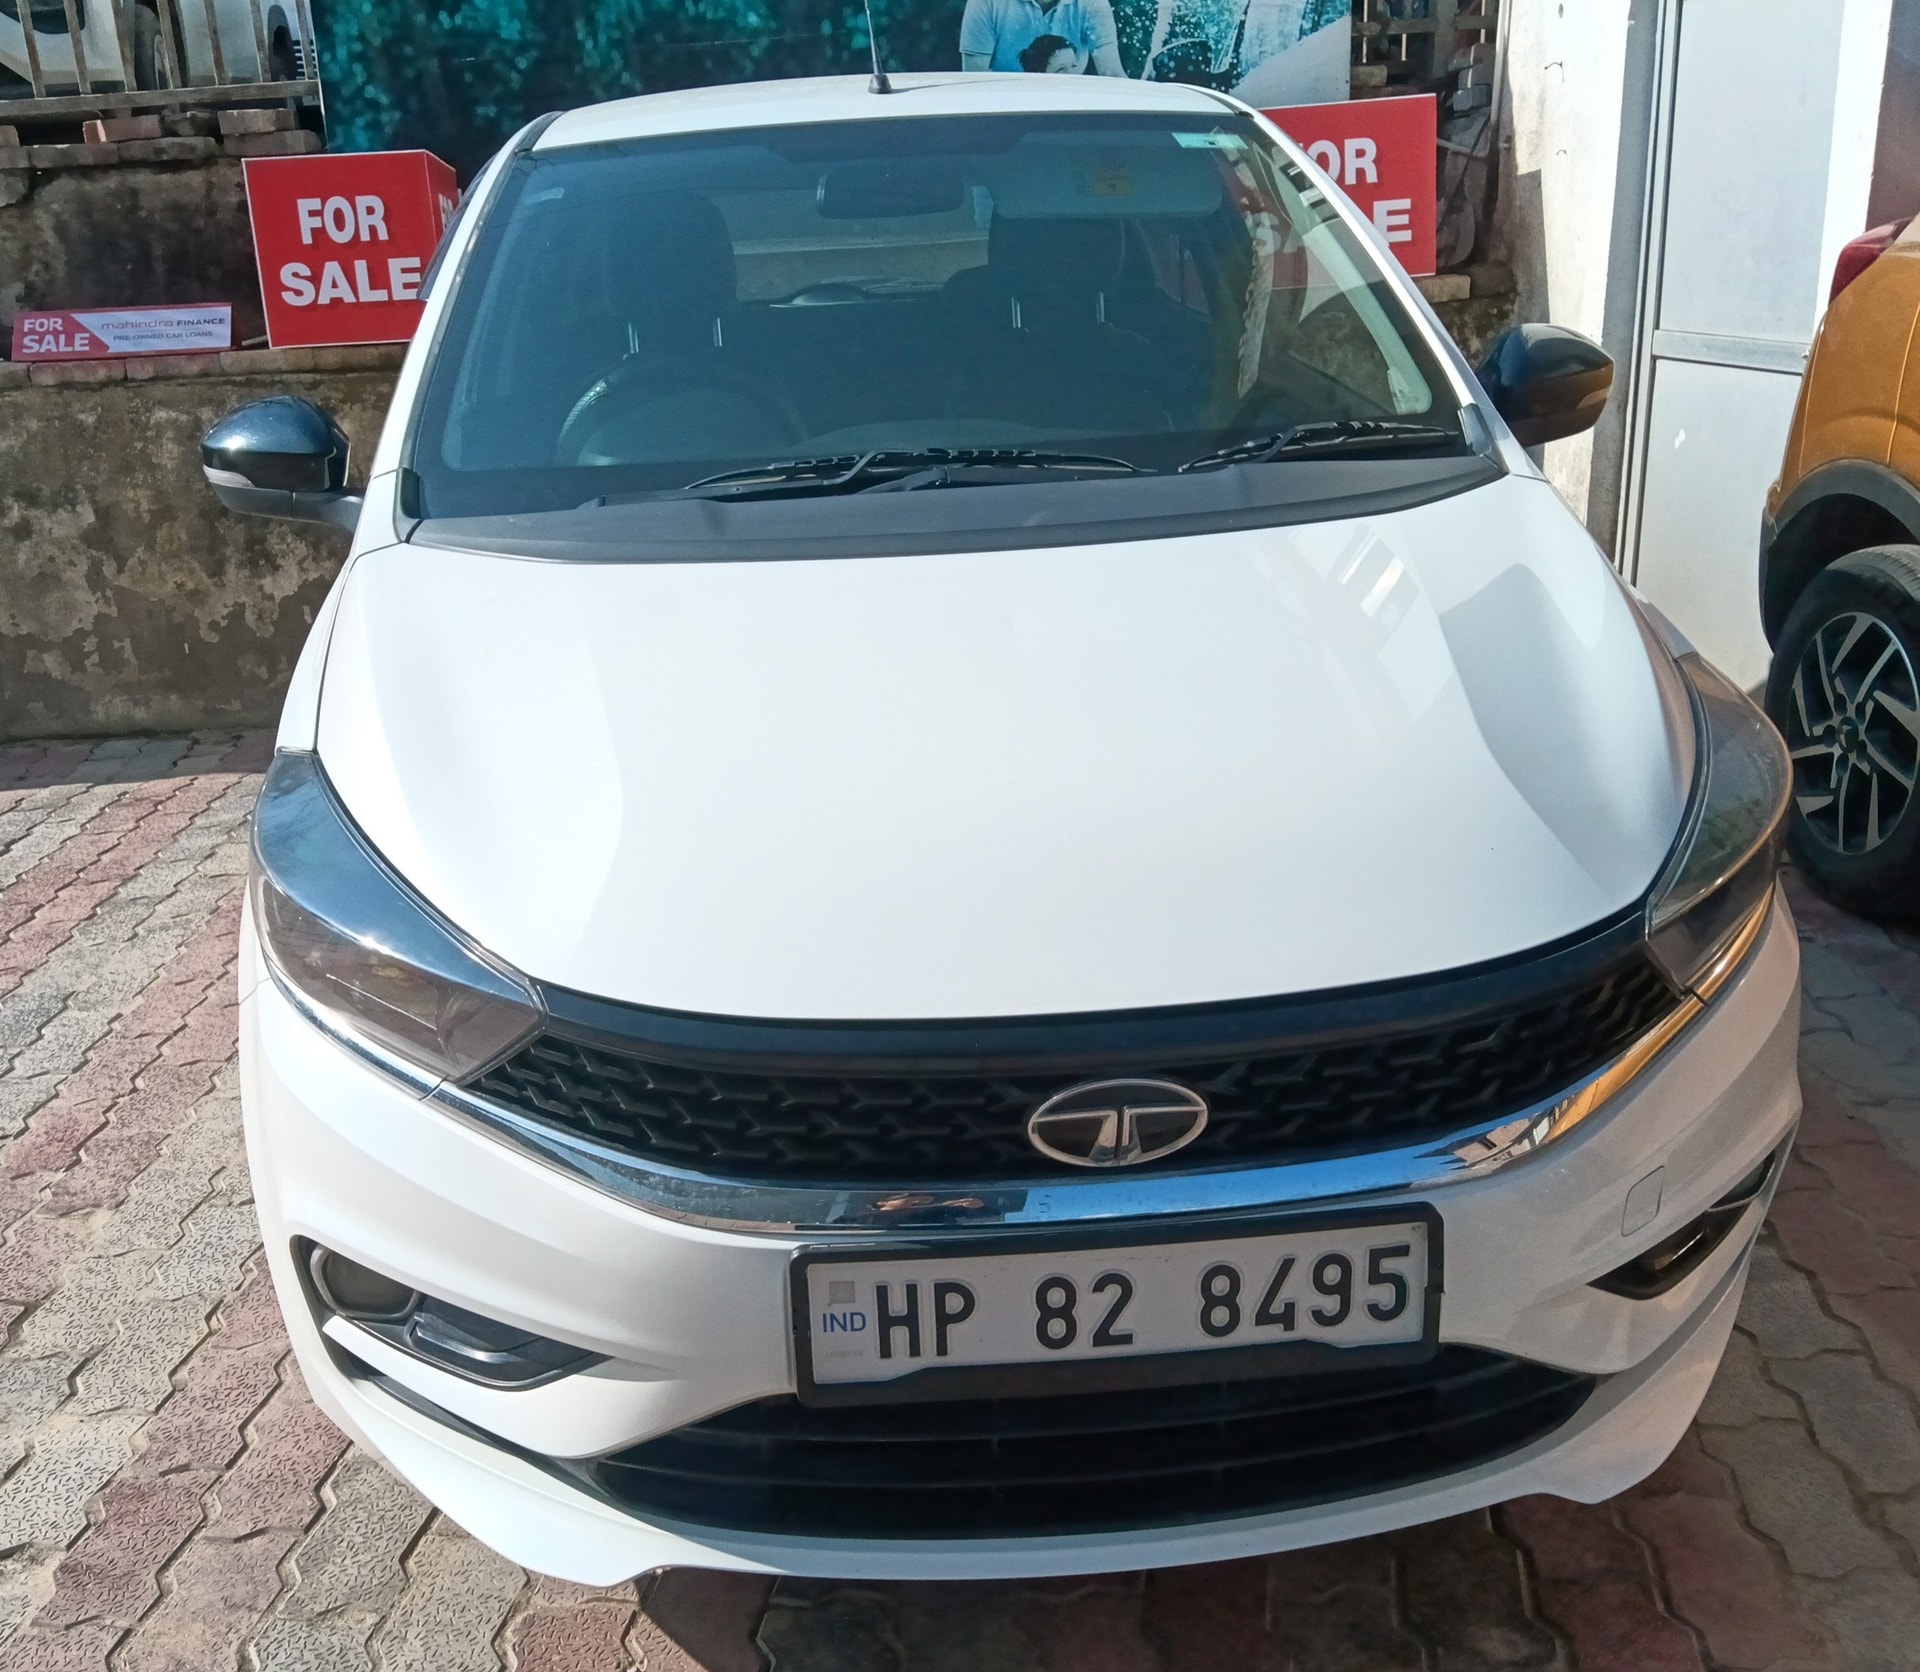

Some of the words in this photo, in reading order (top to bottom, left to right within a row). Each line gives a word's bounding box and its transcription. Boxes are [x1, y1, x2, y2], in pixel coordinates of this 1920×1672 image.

[1299, 138, 1378, 185] OR
[297, 195, 389, 245] FOR
[280, 257, 421, 307] SALE
[23, 317, 63, 332] FOR
[101, 319, 173, 330] mahindra
[176, 317, 225, 327] FINANCE
[22, 332, 90, 353] SALE
[113, 332, 164, 342] PRE-OWNED
[166, 331, 183, 339] CAR
[185, 330, 214, 338] LOANS
[876, 1282, 976, 1358] HP
[1035, 1272, 1134, 1350] 82
[1200, 1244, 1411, 1338] 8495
[822, 1312, 867, 1333] IND
